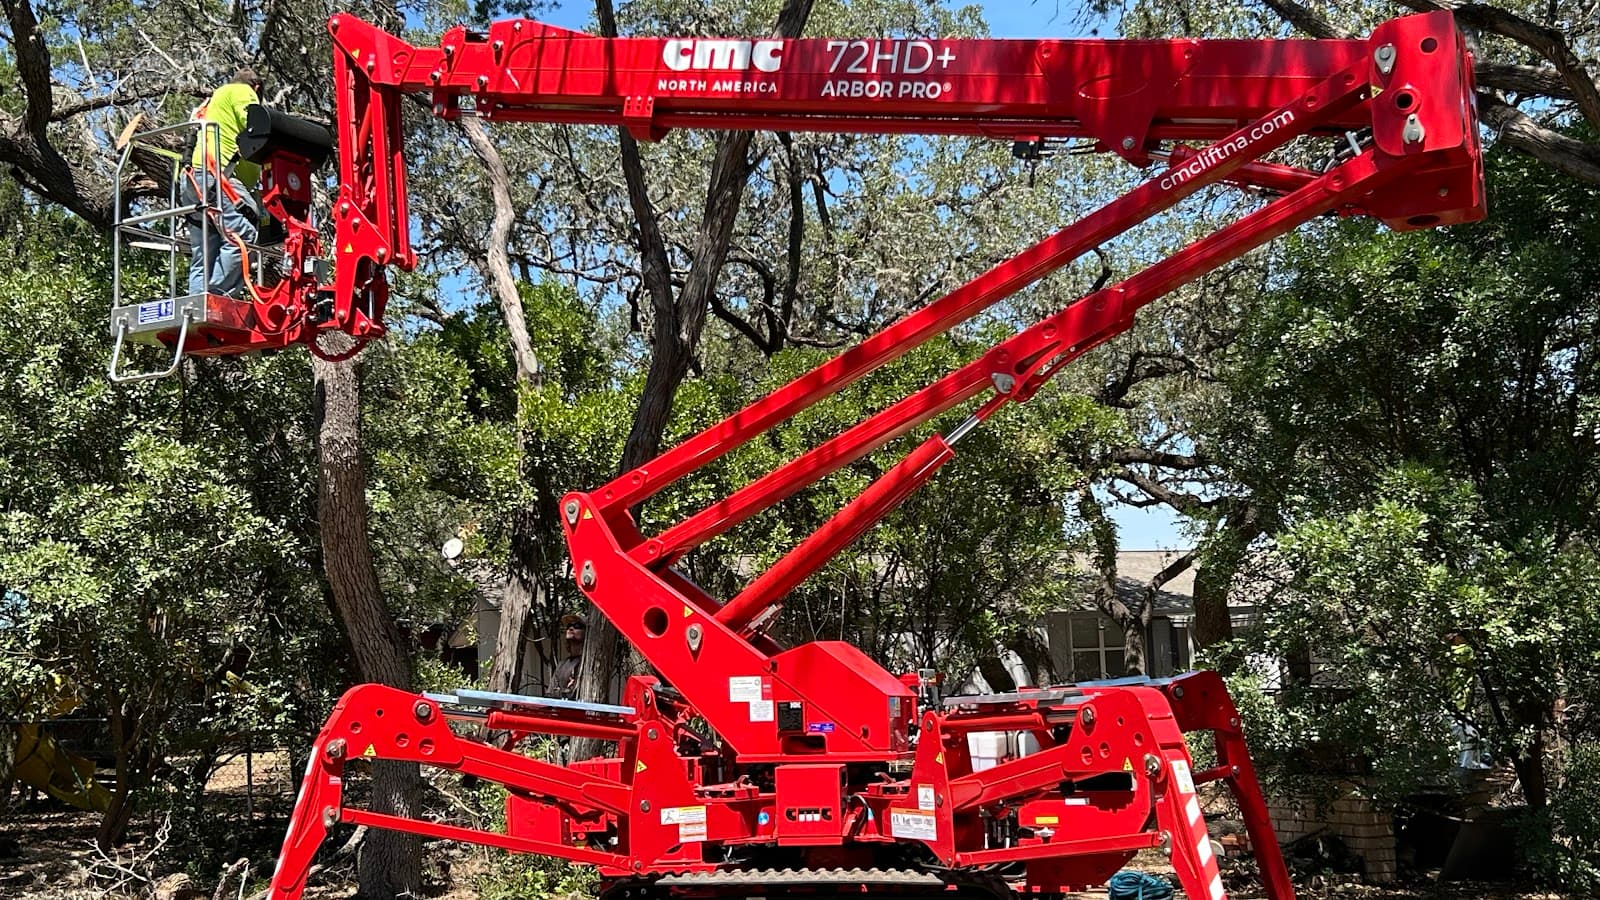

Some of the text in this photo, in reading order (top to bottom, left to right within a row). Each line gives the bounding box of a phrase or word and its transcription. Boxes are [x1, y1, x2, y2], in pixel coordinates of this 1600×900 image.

[826, 40, 956, 74] 72HD+
[658, 80, 777, 93] NORTH AMERICA
[820, 80, 894, 98] ARBOR
[1160, 110, 1295, 191] cmcliftna.com
